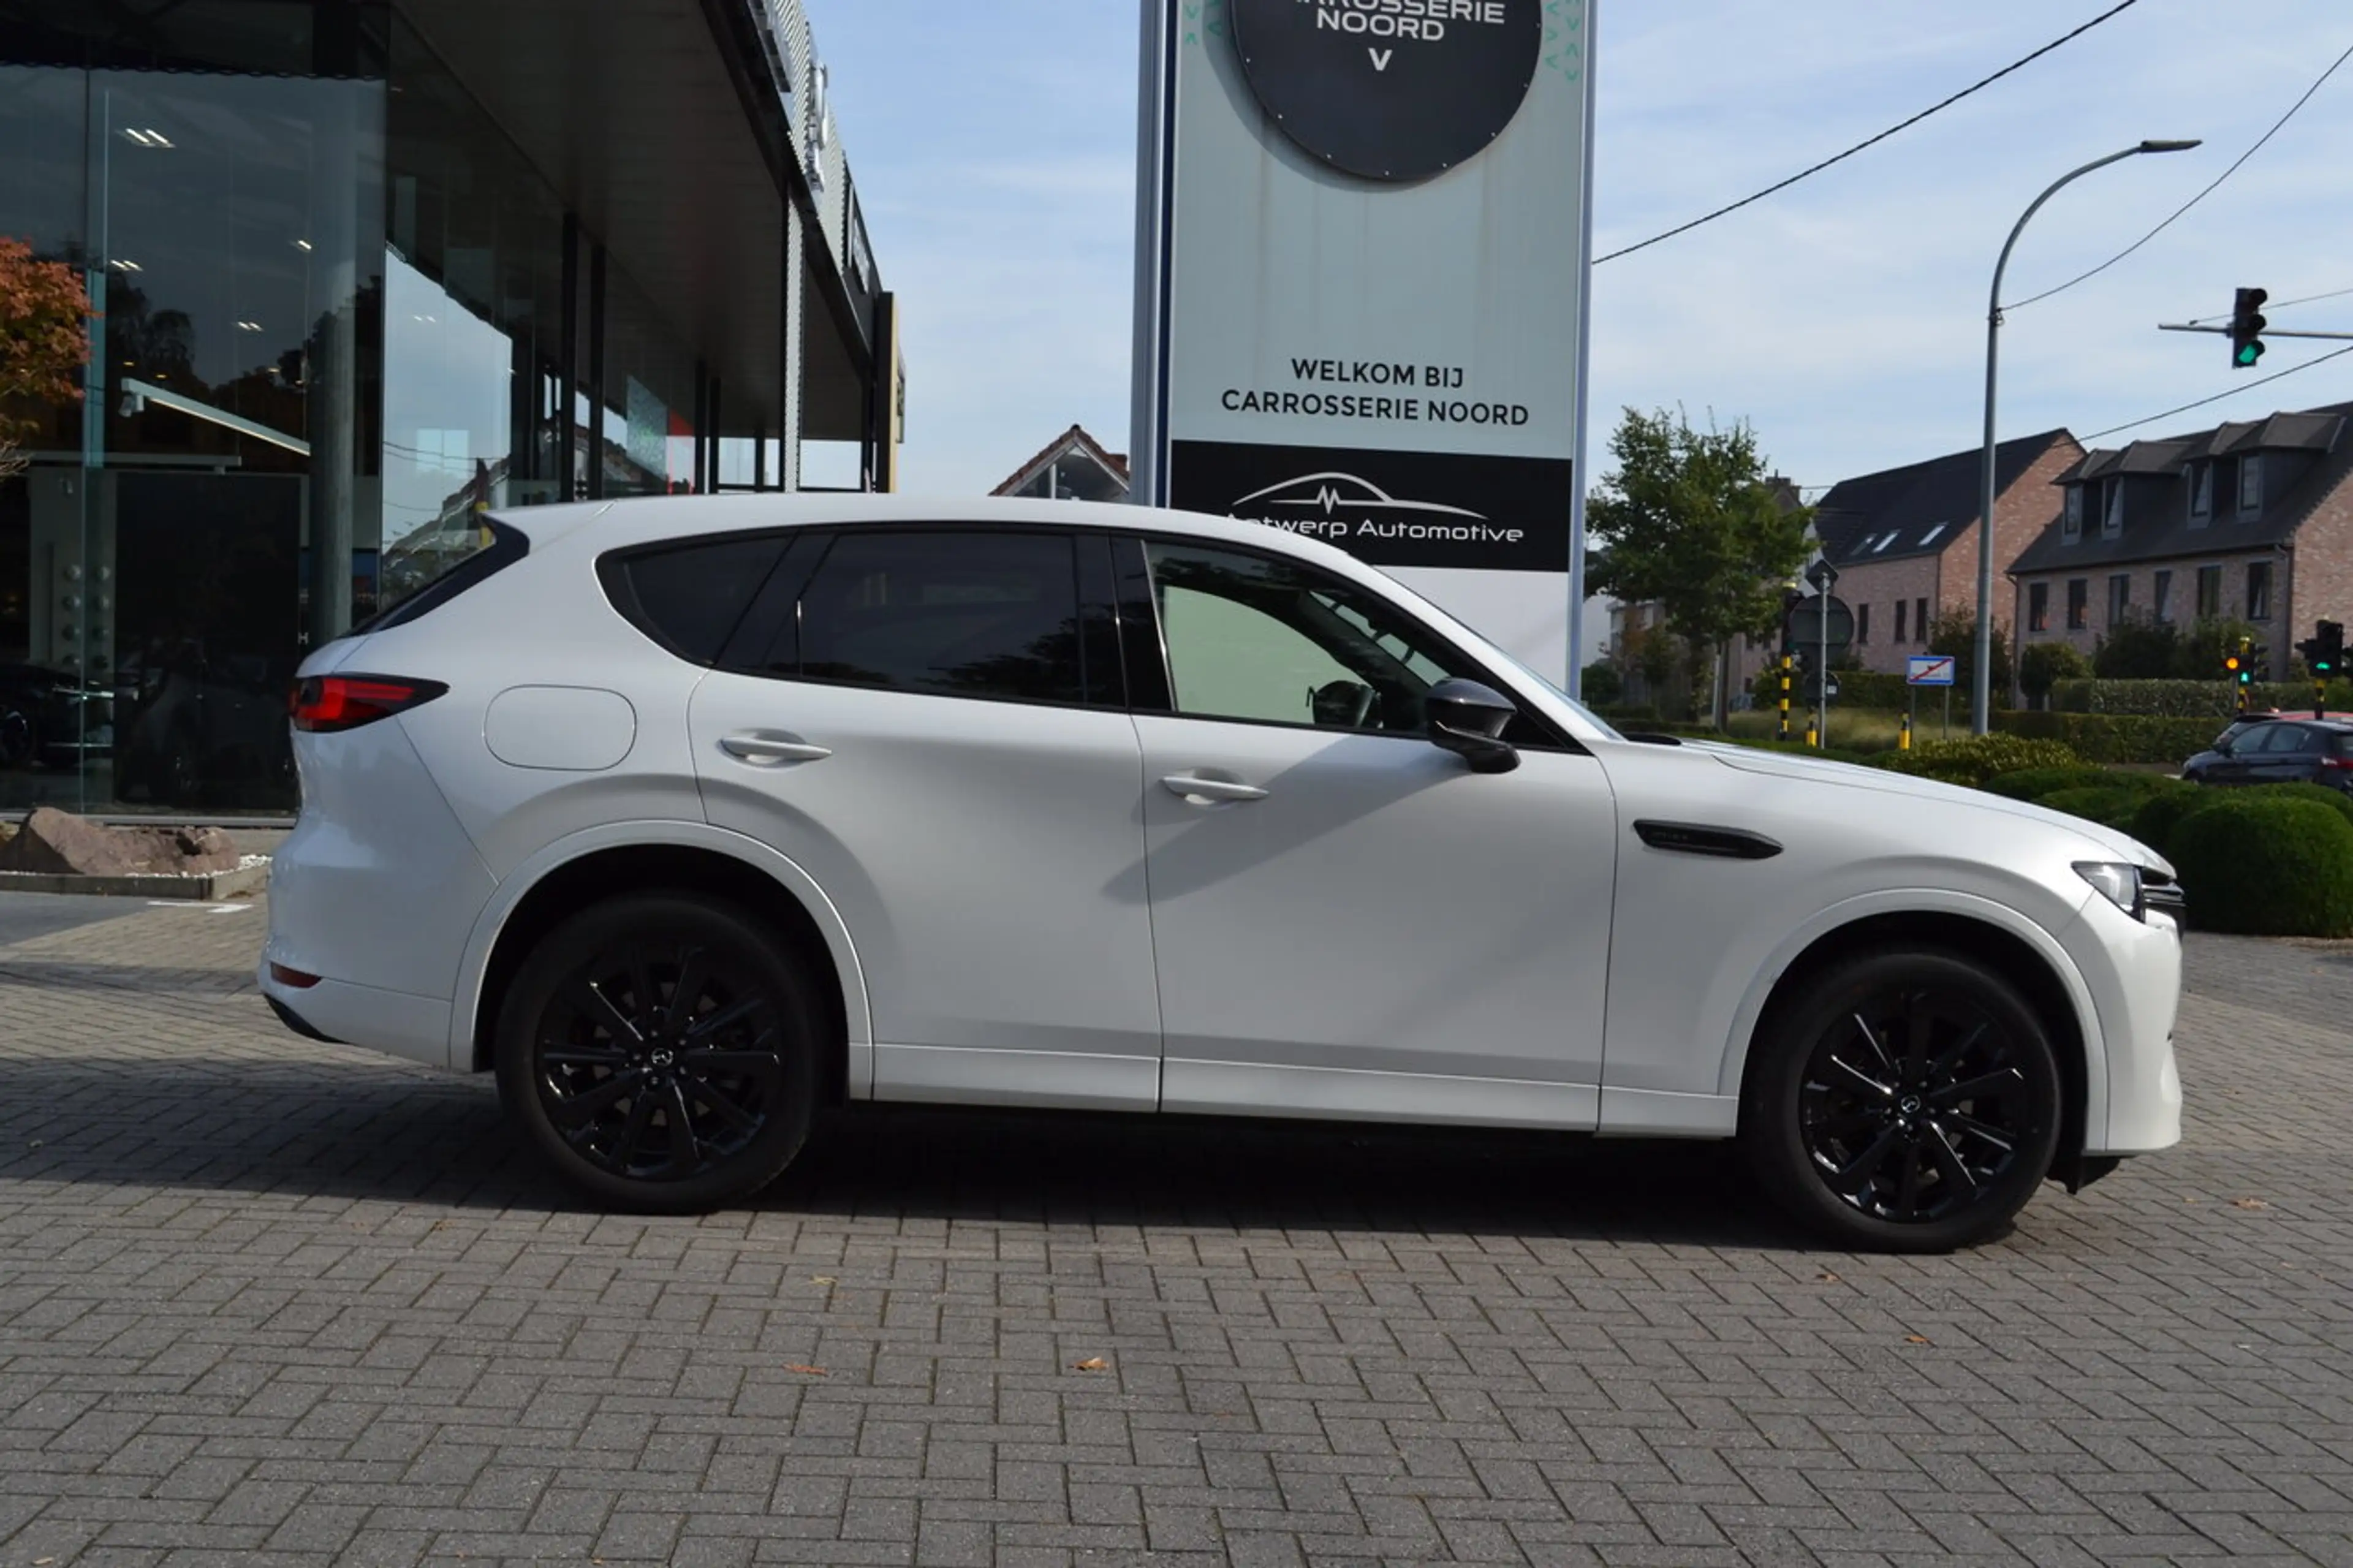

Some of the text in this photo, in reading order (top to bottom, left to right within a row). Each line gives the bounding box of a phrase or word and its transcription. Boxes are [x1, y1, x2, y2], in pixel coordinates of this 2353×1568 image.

[1317, 7, 1444, 40] NOORD
[1292, 358, 1463, 388] WELKOM BIJ
[1221, 388, 1528, 425] CARROSSERIE NOORD
[1228, 513, 1523, 542] twerp Automotive
